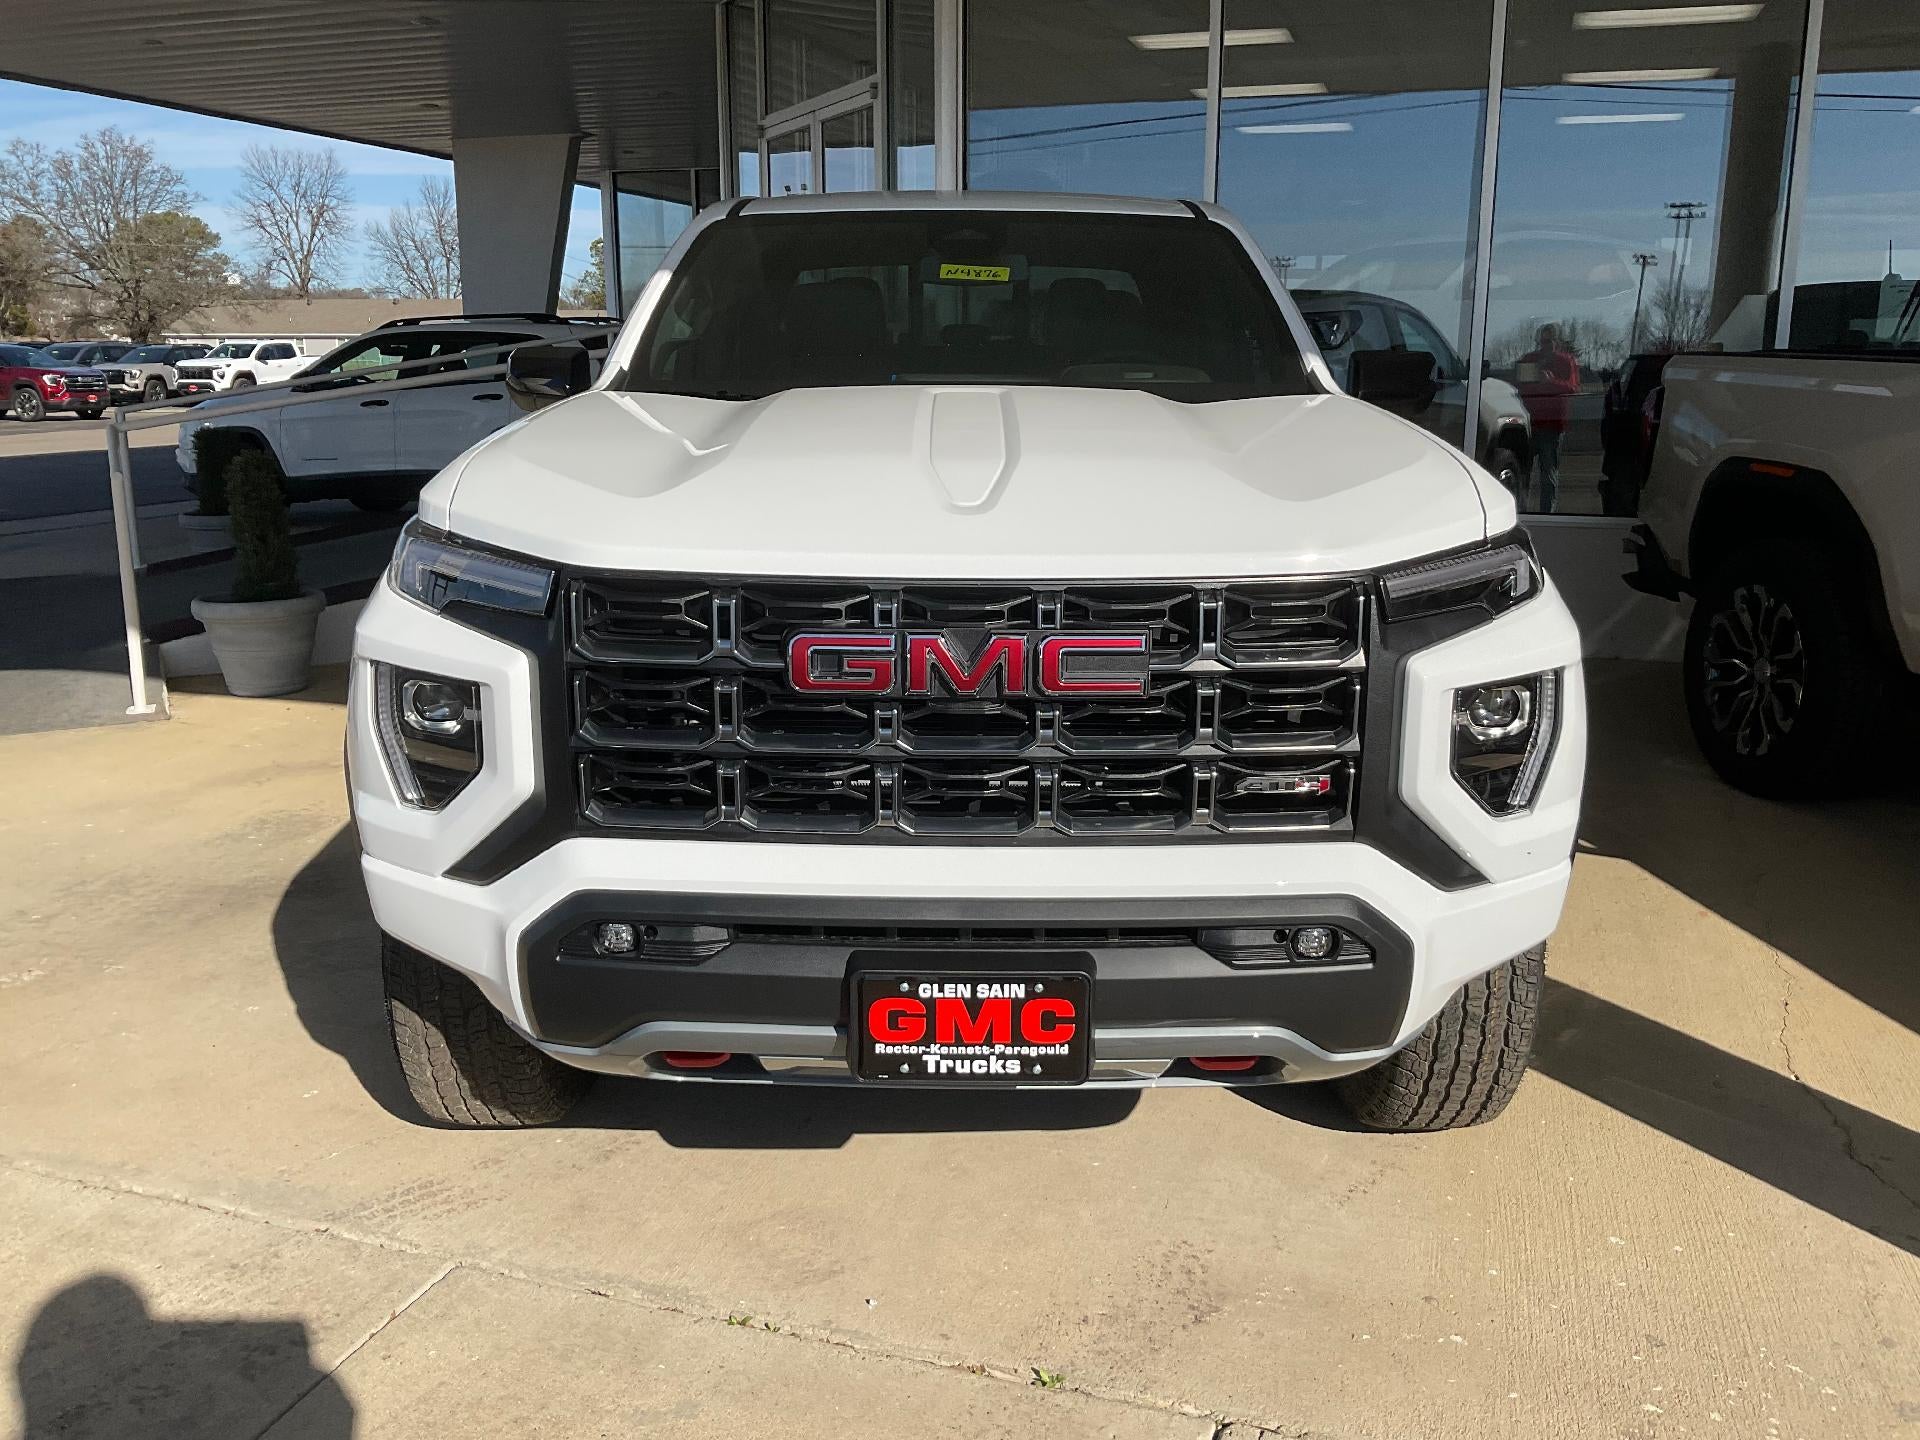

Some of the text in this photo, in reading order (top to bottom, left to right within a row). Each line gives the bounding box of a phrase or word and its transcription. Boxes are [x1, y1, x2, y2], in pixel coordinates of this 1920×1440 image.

[945, 267, 1001, 278] N4876
[788, 632, 1147, 696] GMC
[918, 983, 1026, 998] GLEN SAIN
[868, 997, 1076, 1044] GMC
[922, 1055, 1021, 1074] Trucks
